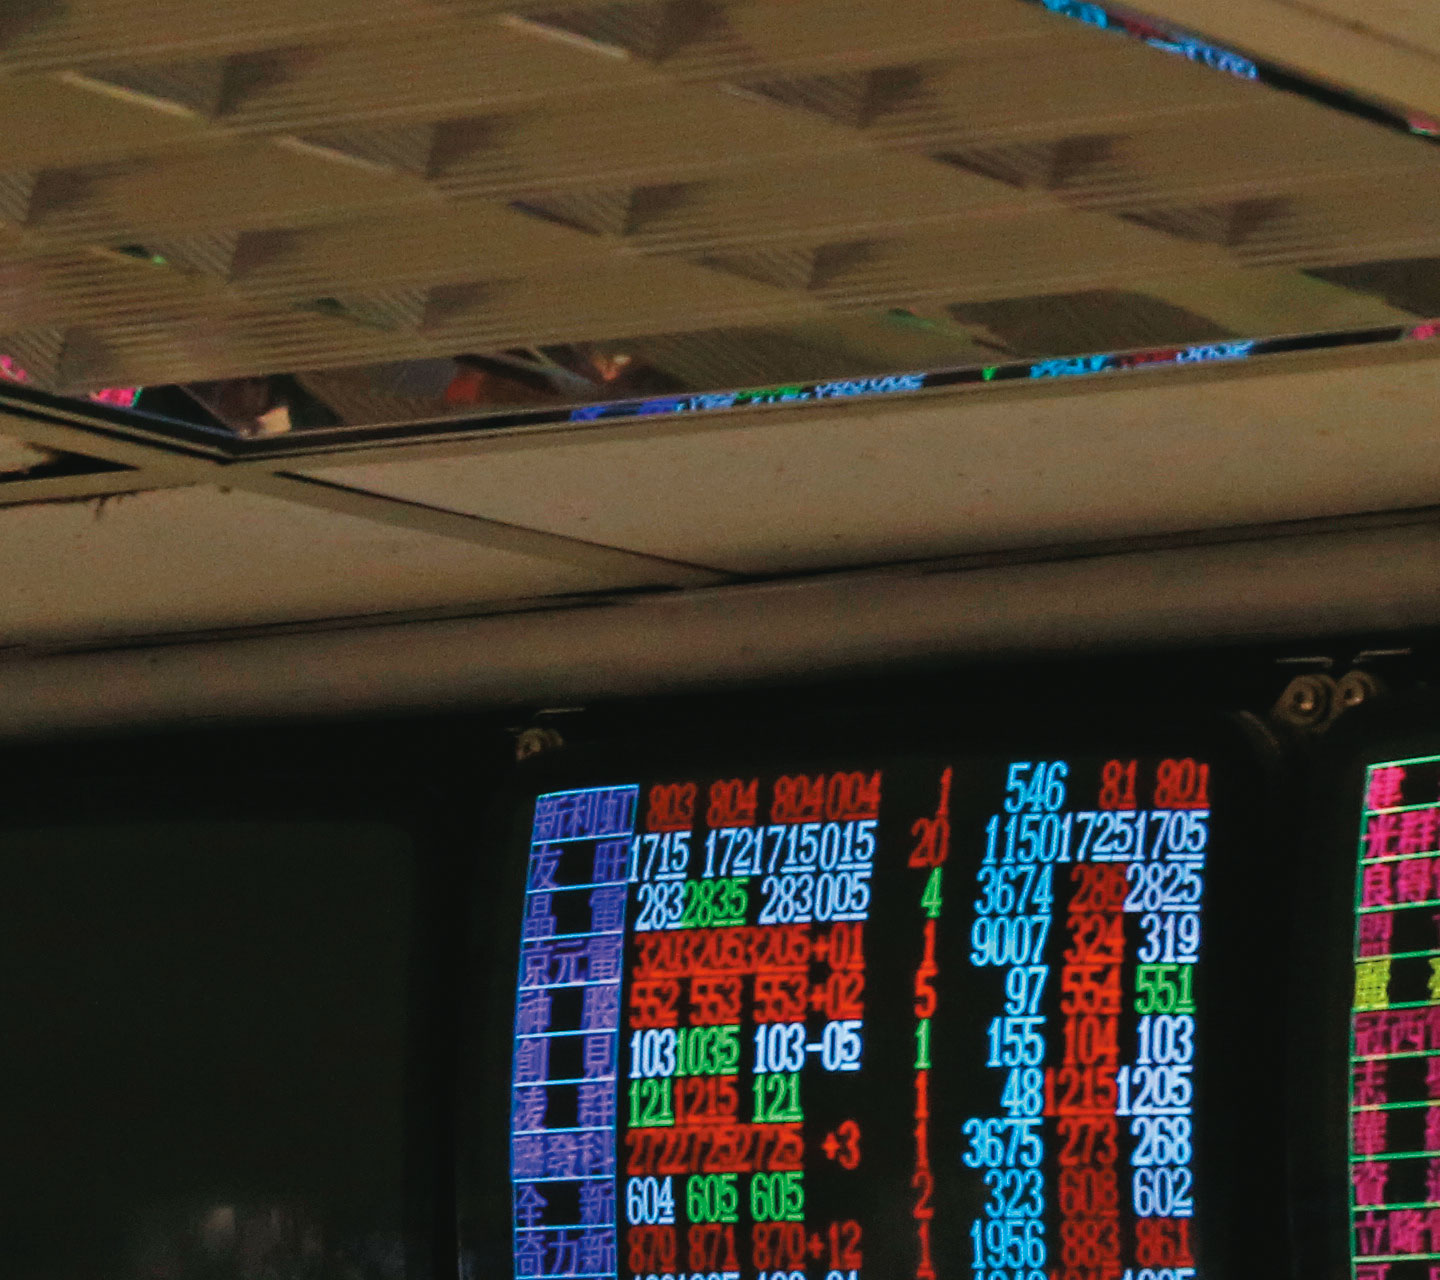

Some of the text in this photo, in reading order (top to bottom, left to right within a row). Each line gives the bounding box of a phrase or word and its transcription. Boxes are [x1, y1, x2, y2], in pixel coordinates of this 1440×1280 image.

[1005, 764, 1066, 812] 546
[1134, 811, 1208, 861] 1705
[976, 864, 1201, 914] 3674 2825
[971, 917, 1049, 965] 9007
[1140, 914, 1198, 962] 319
[1006, 965, 1194, 1014] 97 551
[987, 1016, 1192, 1066] 155 103
[1001, 1070, 1044, 1118] 48
[963, 1118, 1191, 1168] 3675 268
[627, 1169, 1191, 1224] 604 323 602
[971, 1222, 1045, 1269] 1956
